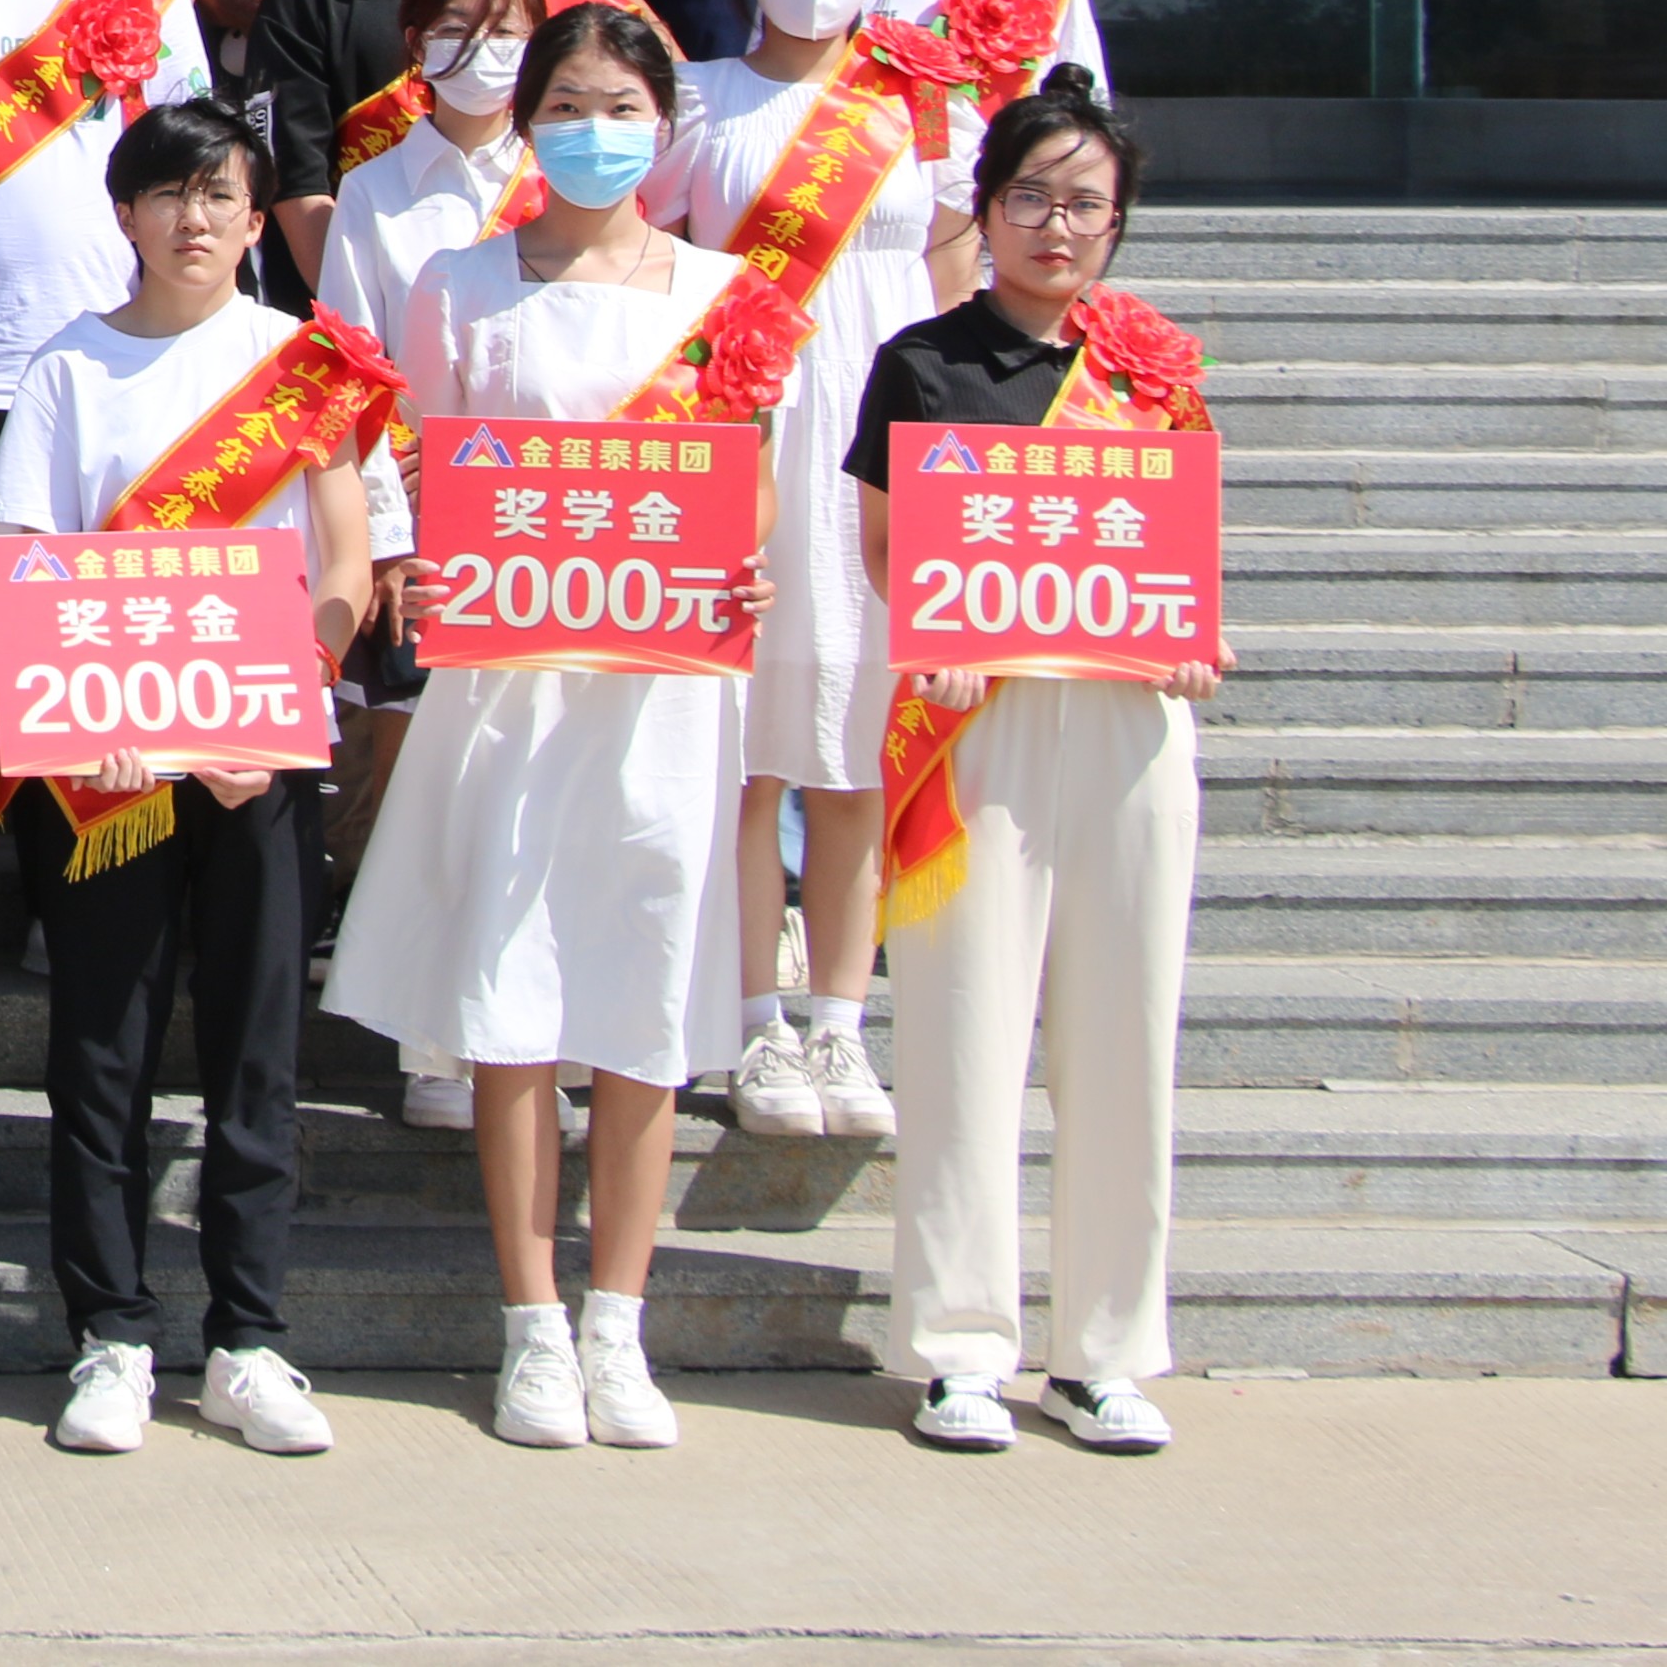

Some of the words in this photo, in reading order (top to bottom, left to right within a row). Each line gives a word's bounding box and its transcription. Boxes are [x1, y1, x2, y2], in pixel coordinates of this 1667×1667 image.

[519, 436, 712, 473] 金玺泰集团
[985, 443, 1173, 479] 金玺泰集团
[493, 487, 682, 542] 奖学金
[962, 494, 1146, 548] 奖学金
[74, 544, 260, 580] 金玺泰集团
[440, 553, 731, 634] 2000元
[911, 559, 1197, 639] 2000元
[56, 594, 241, 648] 奖学金
[15, 659, 301, 734] 2000元
